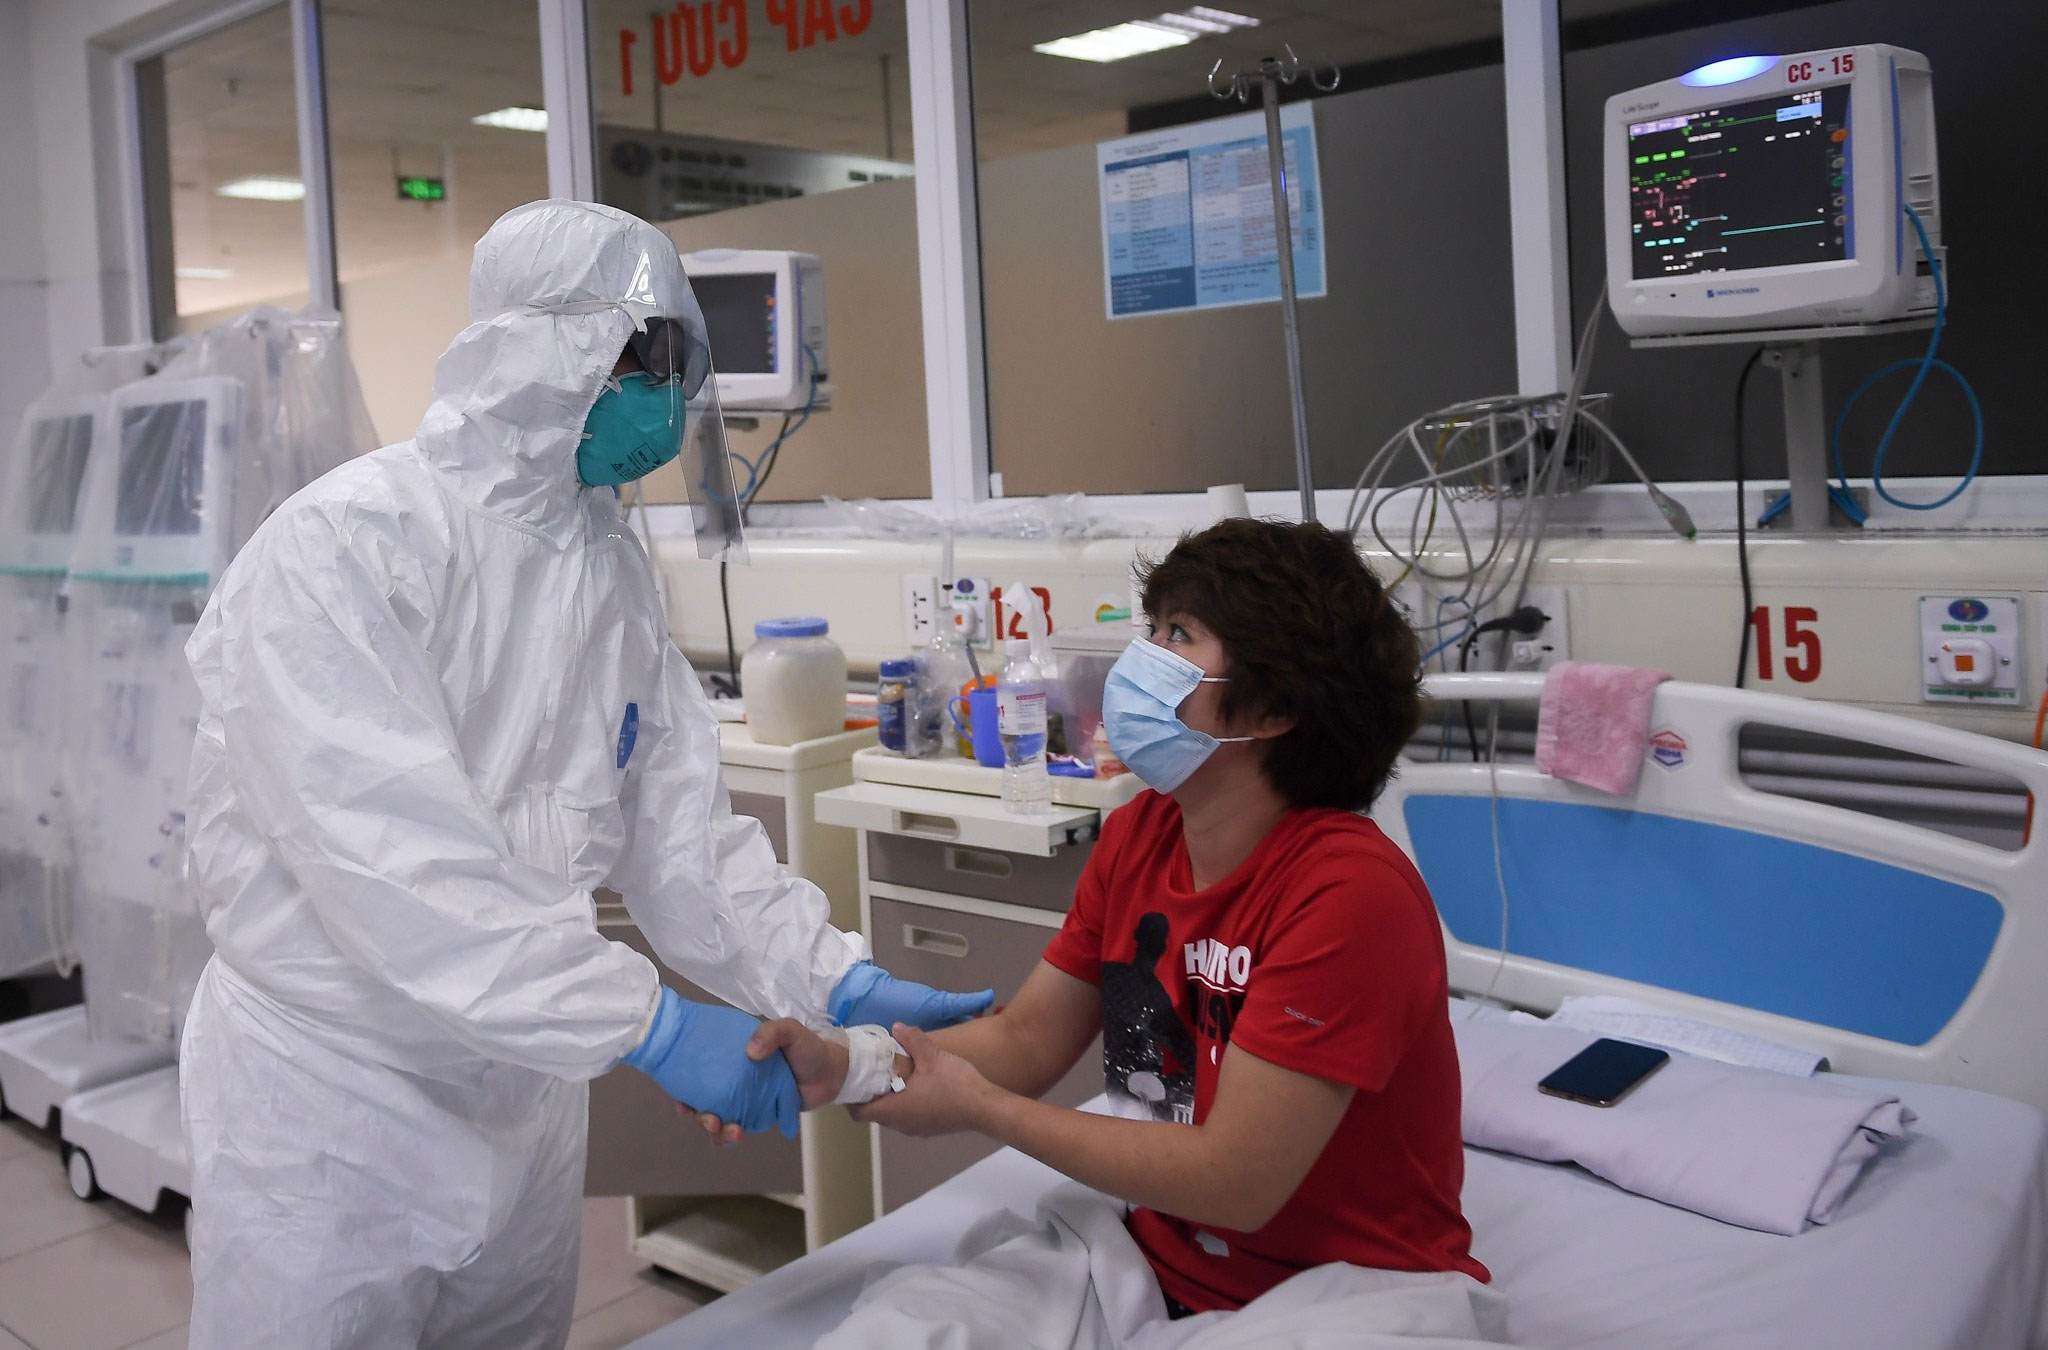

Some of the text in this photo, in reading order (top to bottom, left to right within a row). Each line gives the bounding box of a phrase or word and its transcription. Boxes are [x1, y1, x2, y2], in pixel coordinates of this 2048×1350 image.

[1787, 61, 1813, 84] CC
[1832, 54, 1855, 78] 15
[1750, 605, 1823, 683] 15
